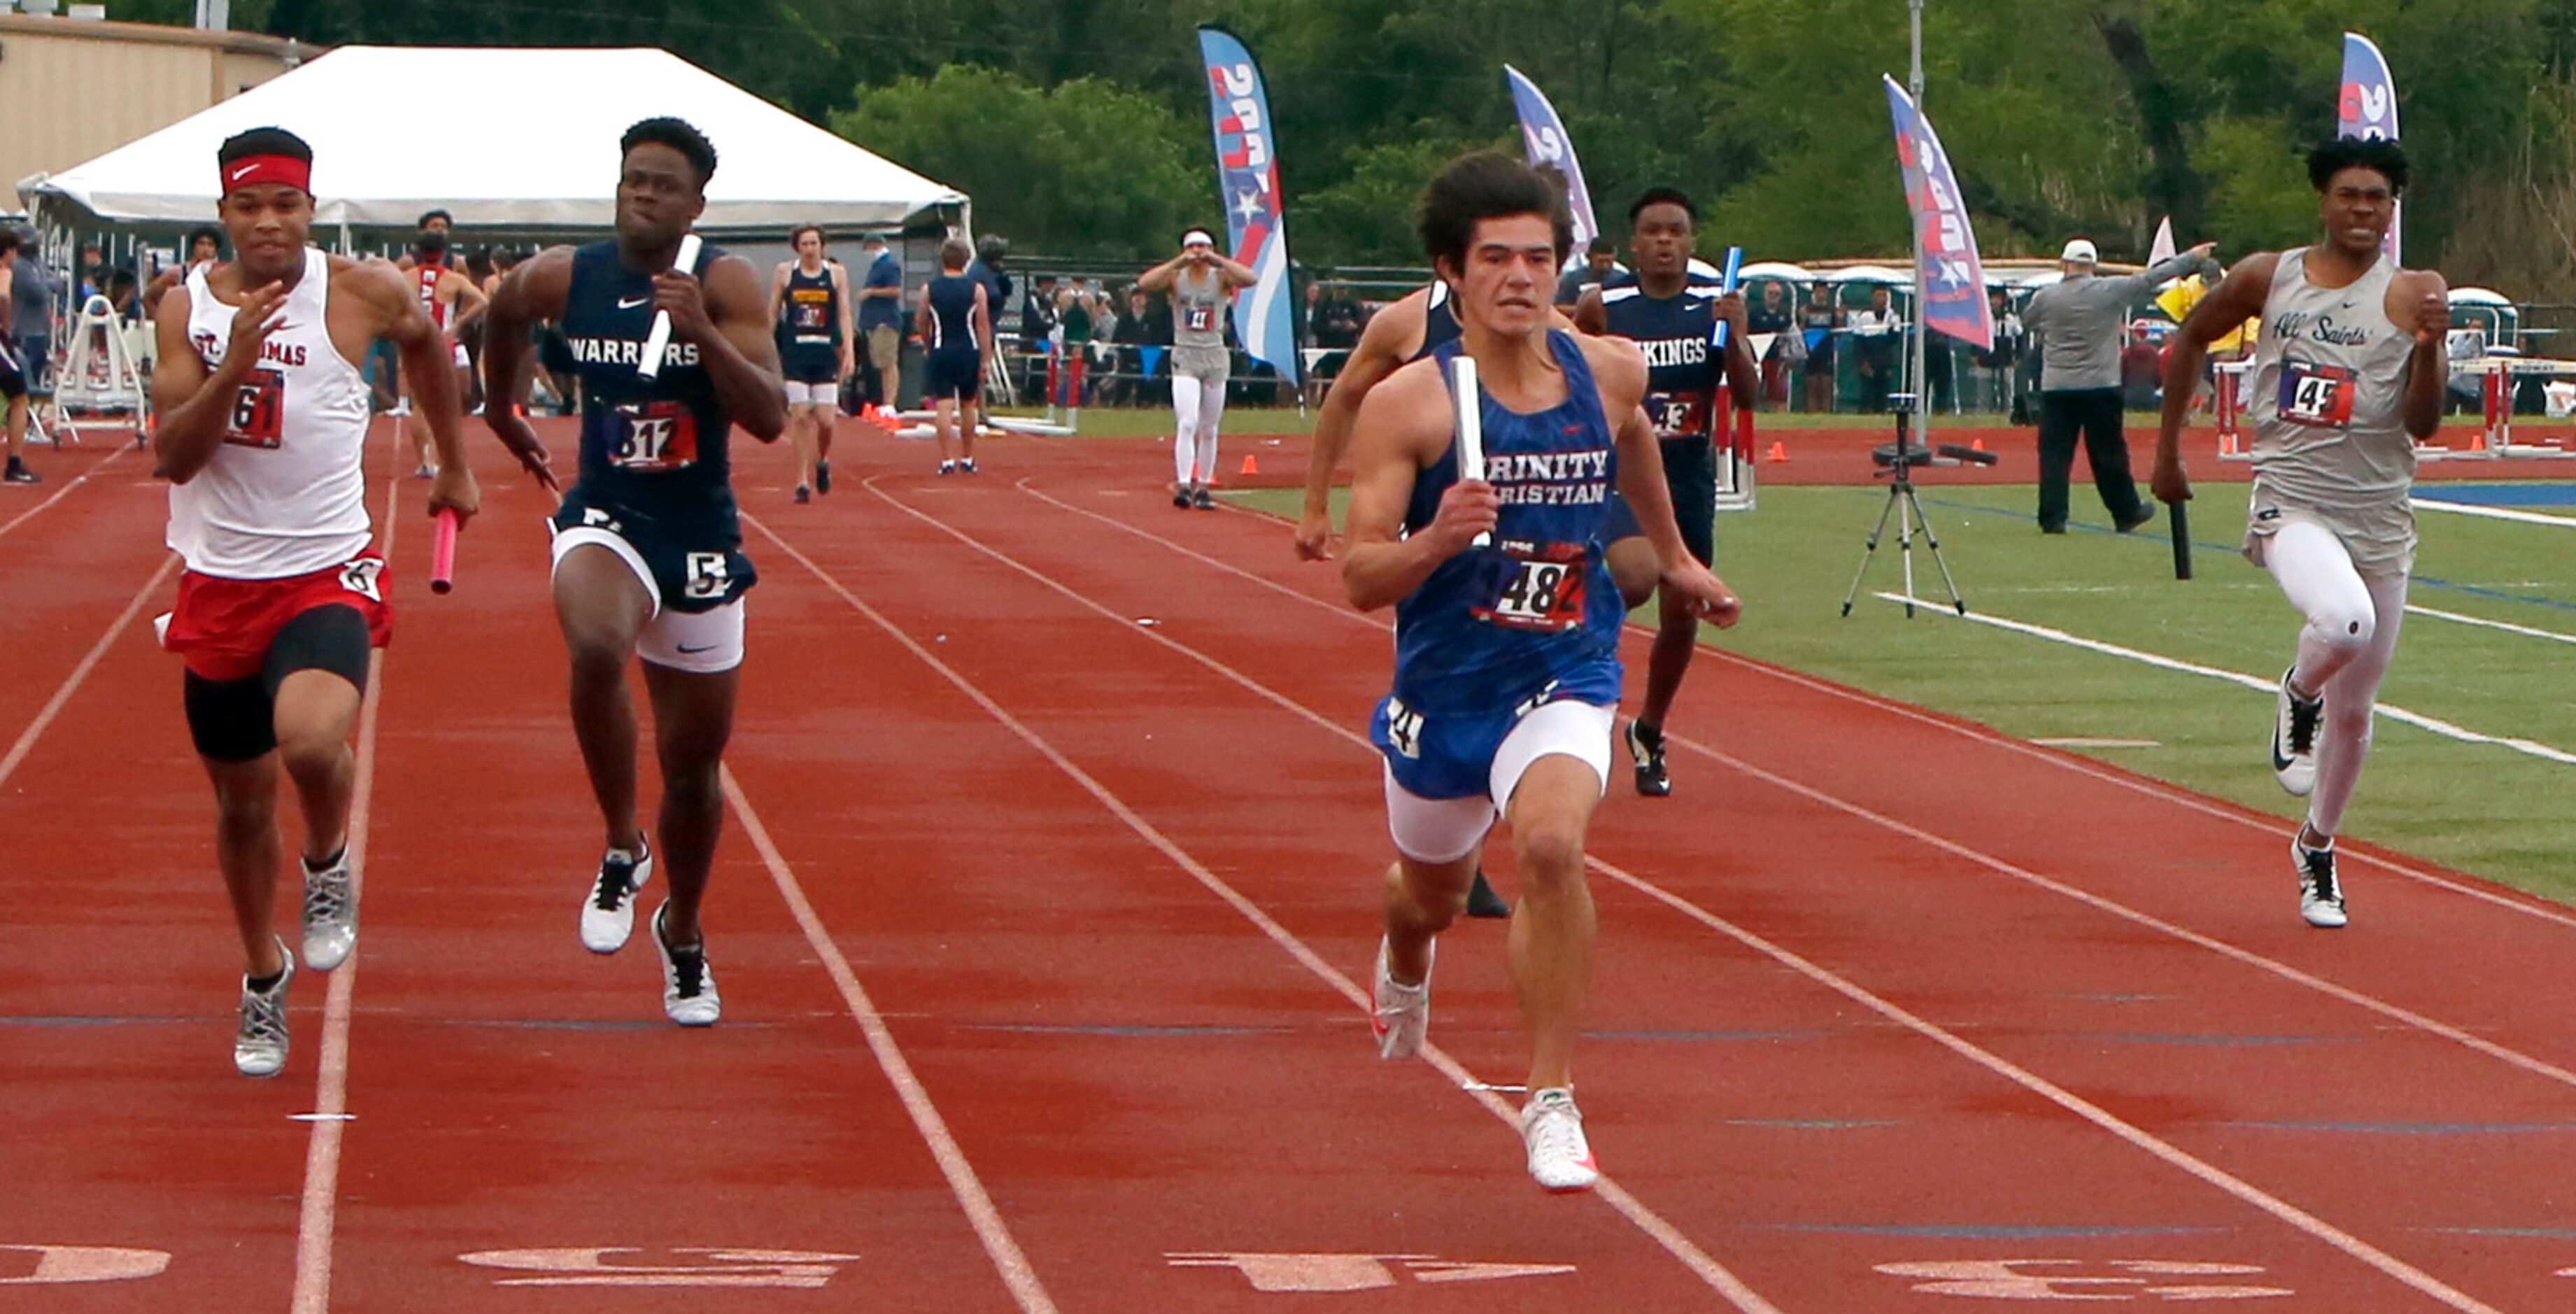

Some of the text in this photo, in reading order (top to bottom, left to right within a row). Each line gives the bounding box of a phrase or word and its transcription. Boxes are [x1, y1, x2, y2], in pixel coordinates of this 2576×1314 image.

[1636, 337, 1707, 367] KINGS
[2299, 379, 2339, 411] 45
[1482, 450, 1608, 481] RINITY
[1493, 483, 1606, 504] RISTIAN
[348, 560, 374, 592] 6
[697, 556, 715, 595] 5
